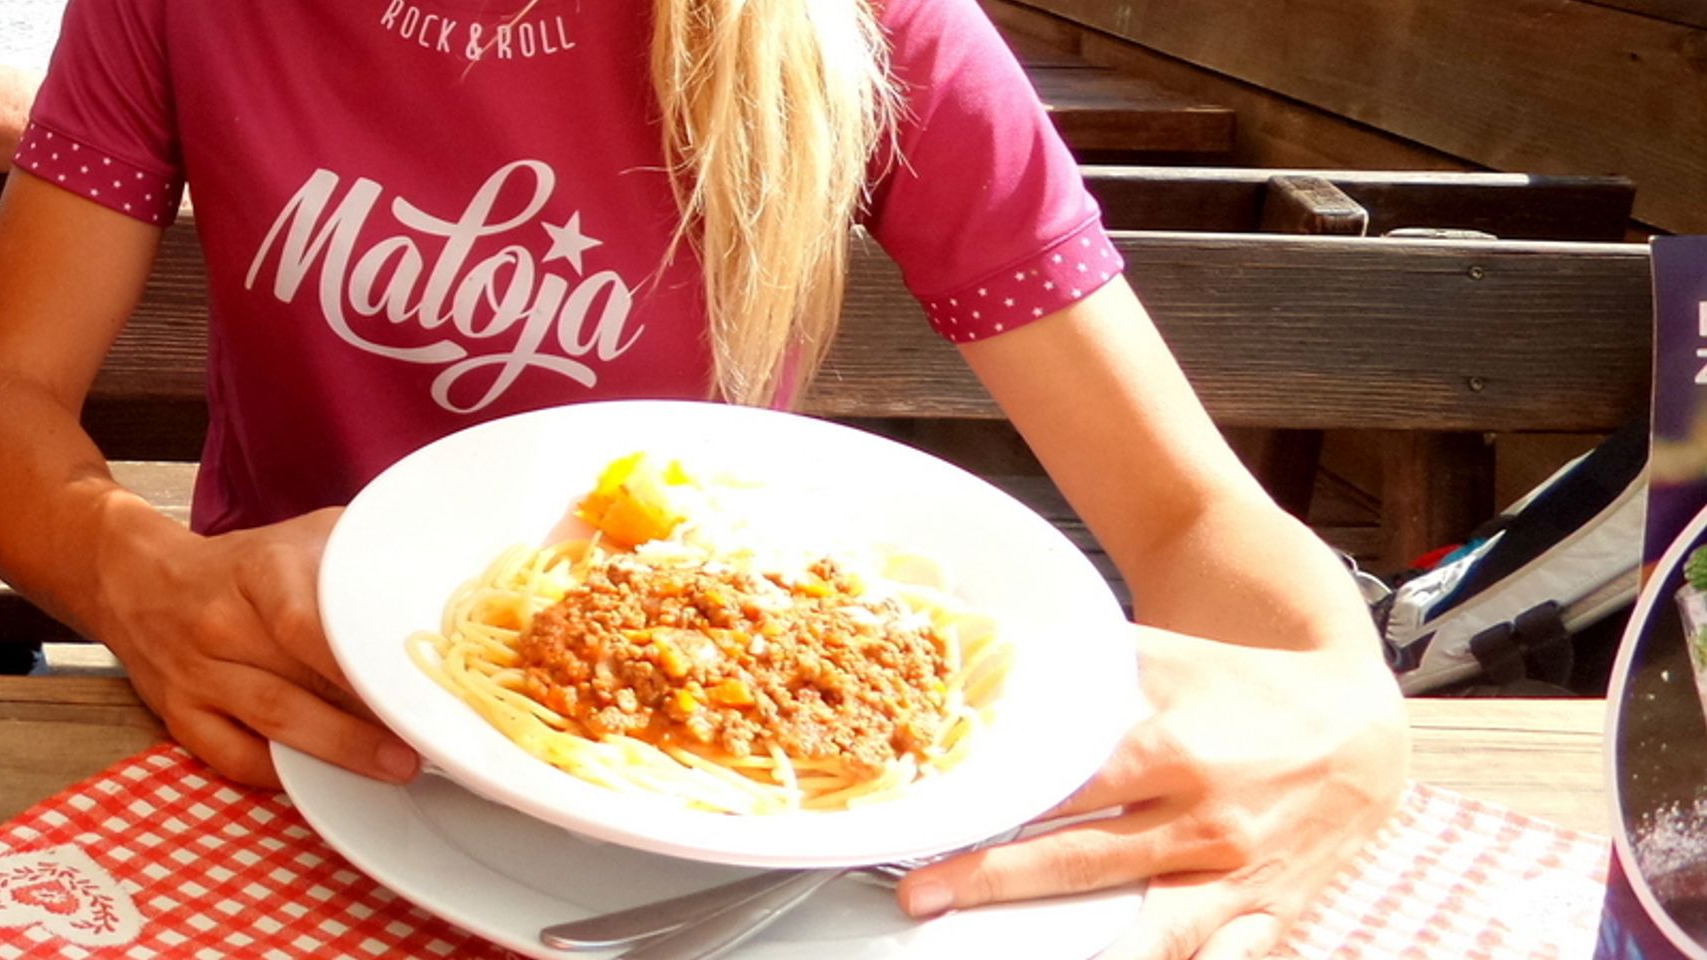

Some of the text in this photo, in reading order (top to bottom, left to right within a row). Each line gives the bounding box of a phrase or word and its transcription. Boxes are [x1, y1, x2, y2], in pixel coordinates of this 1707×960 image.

[465, 22, 483, 61] &
[497, 16, 576, 59] ROLL
[245, 159, 645, 414] Maloja
